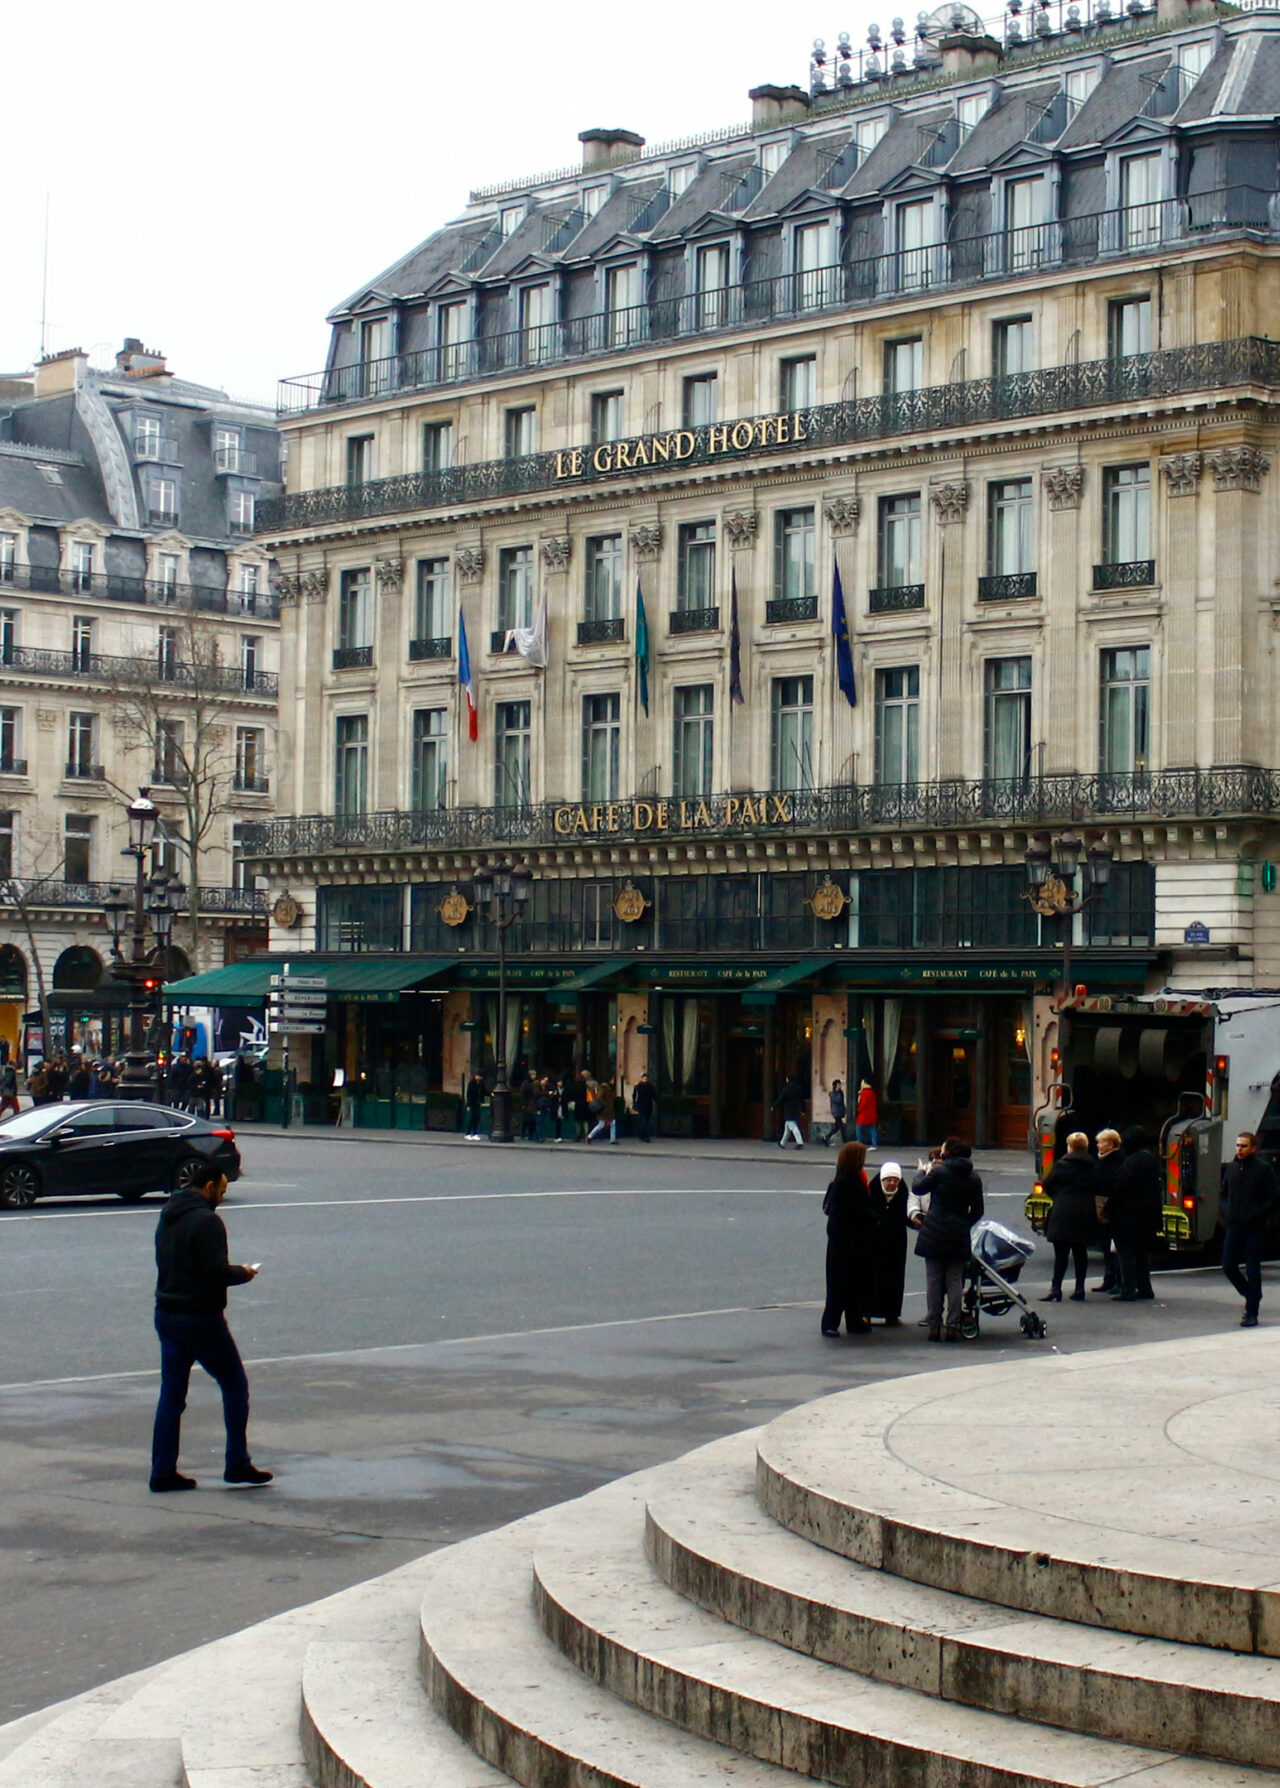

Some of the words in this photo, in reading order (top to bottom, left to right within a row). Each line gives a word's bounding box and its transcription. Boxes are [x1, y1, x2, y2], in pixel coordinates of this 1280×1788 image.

[555, 448, 584, 479] LE
[593, 430, 697, 473] GRAND
[708, 412, 808, 455] HOTEL
[633, 801, 669, 831] DE
[679, 800, 714, 829] LA
[725, 794, 792, 826] PAIX
[922, 969, 969, 978] RESTAURANT
